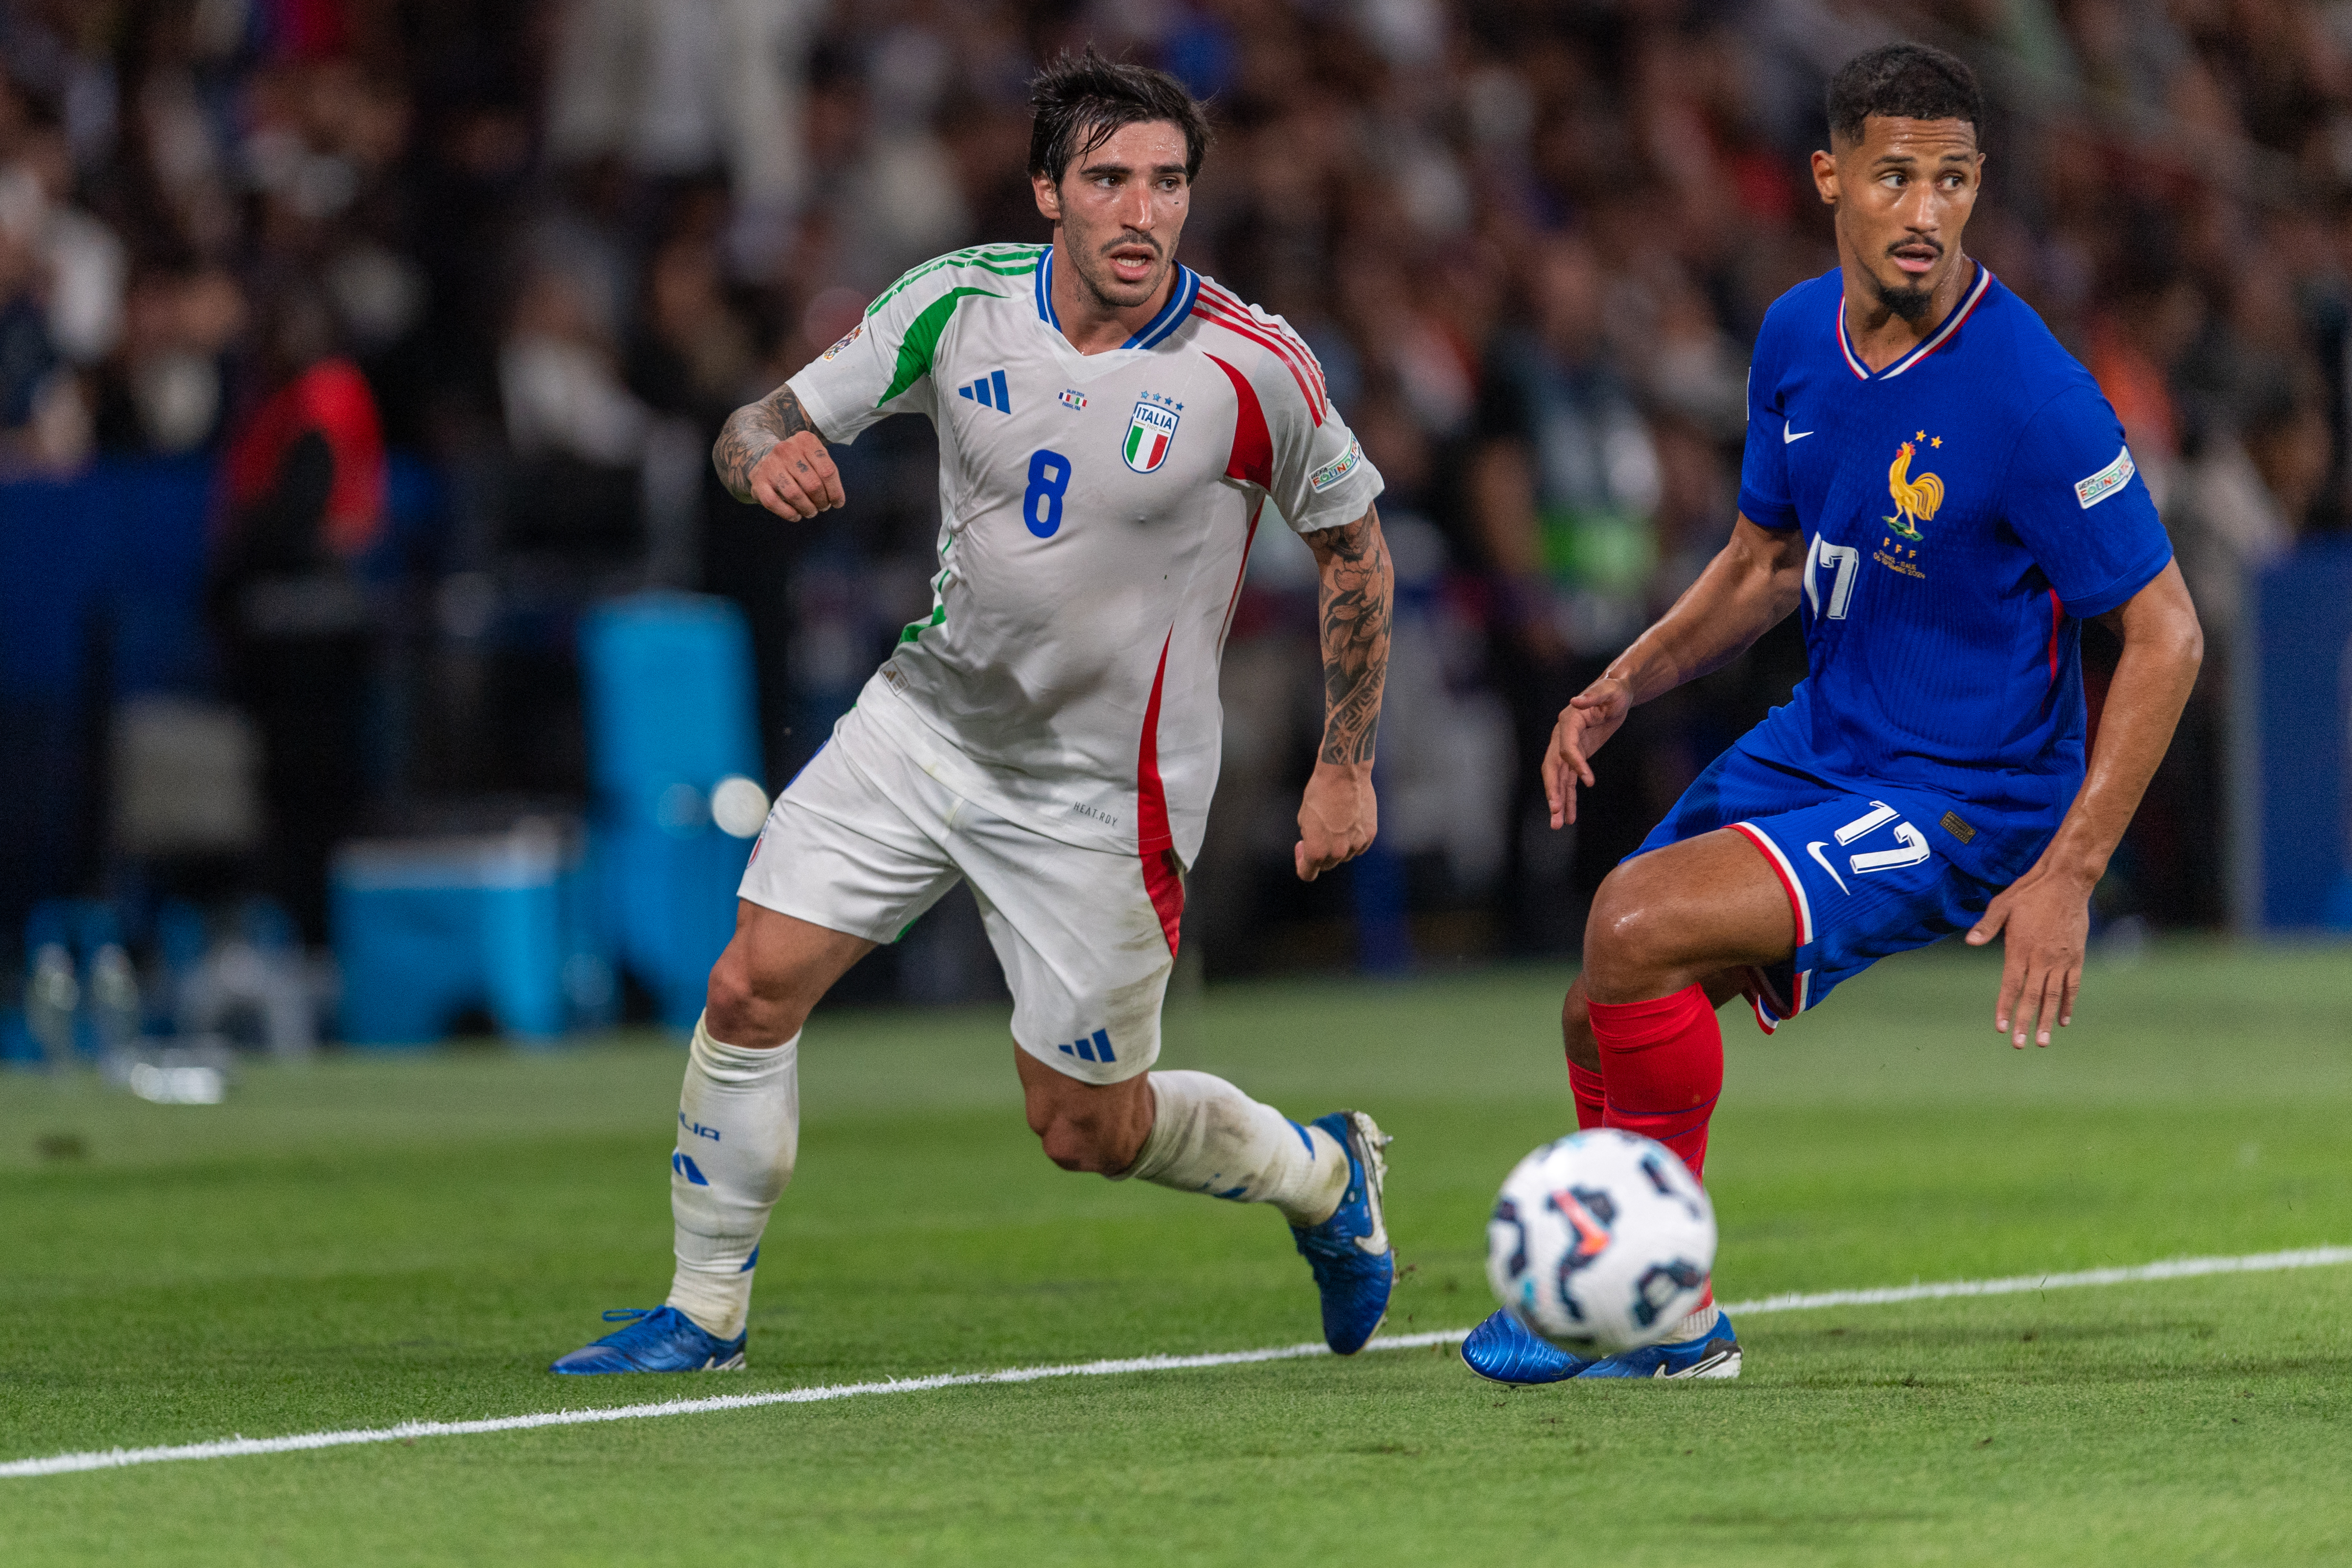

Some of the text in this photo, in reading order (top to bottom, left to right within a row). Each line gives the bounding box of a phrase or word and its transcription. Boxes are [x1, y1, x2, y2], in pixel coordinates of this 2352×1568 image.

[1135, 407, 1172, 430] ITALIA
[1146, 423, 1158, 432] FIGC
[1311, 467, 1328, 479] UEFA
[1023, 449, 1072, 538] 8
[1803, 531, 1859, 620] 17
[1073, 801, 1118, 826] HEAT.RDY
[1834, 800, 1931, 874] 17
